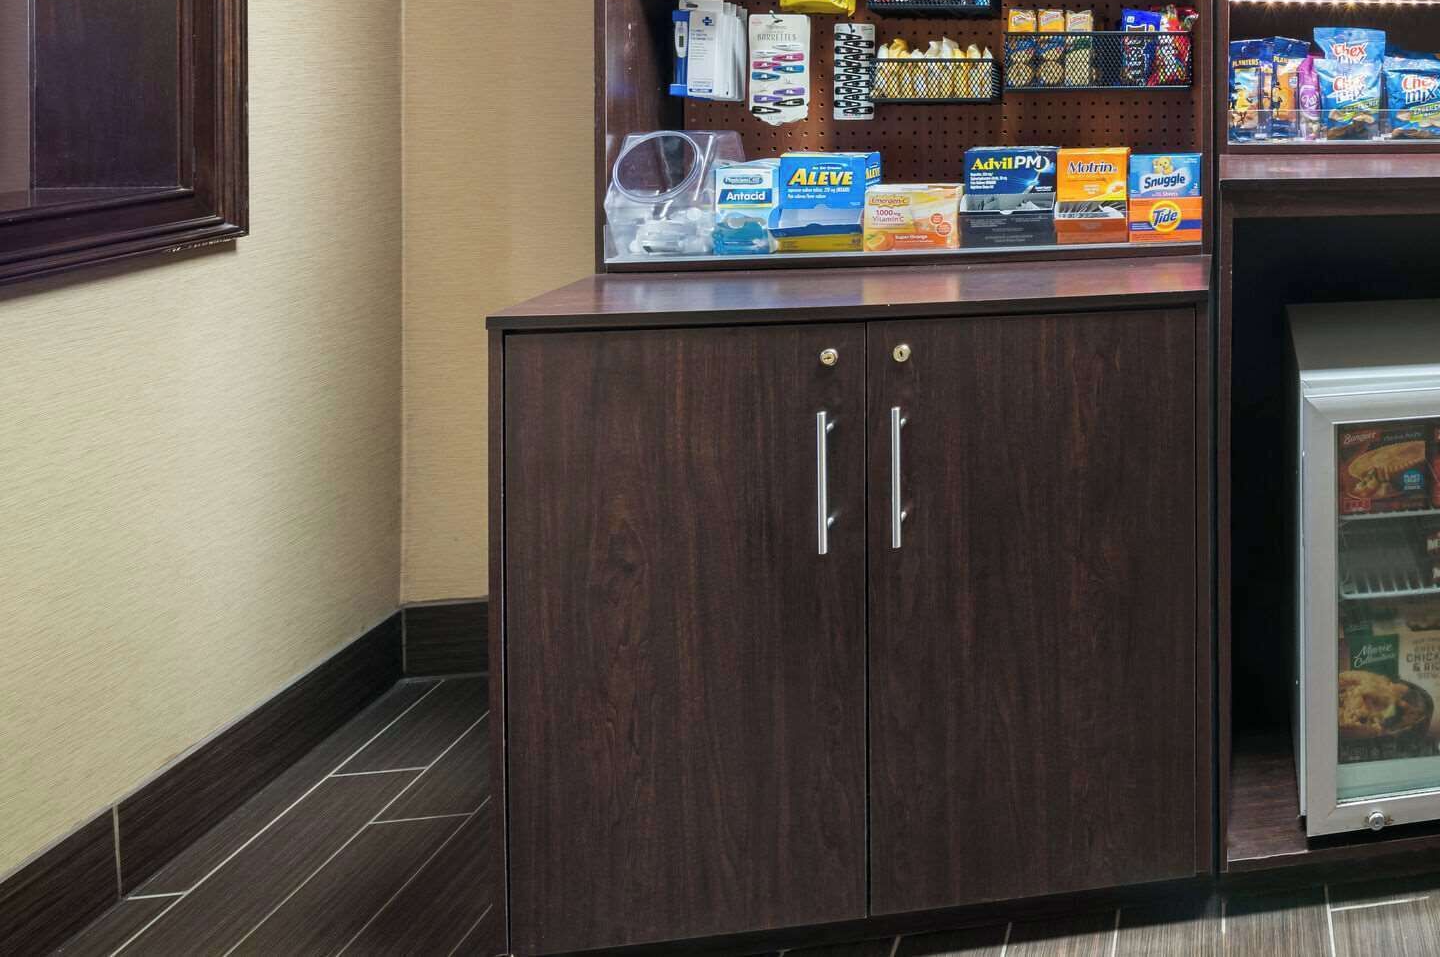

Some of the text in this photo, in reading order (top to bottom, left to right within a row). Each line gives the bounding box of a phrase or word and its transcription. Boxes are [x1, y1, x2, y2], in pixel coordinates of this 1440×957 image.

[1331, 42, 1366, 58] Chex
[1232, 58, 1260, 68] PLANTERS
[971, 155, 1043, 170] Advil PM
[1067, 161, 1113, 174] Motrin
[788, 167, 854, 186] ALEVE
[865, 166, 881, 178] ALEVE
[1143, 172, 1186, 190] Snuggle
[726, 191, 766, 201] Antacid
[1152, 208, 1178, 227] Tide
